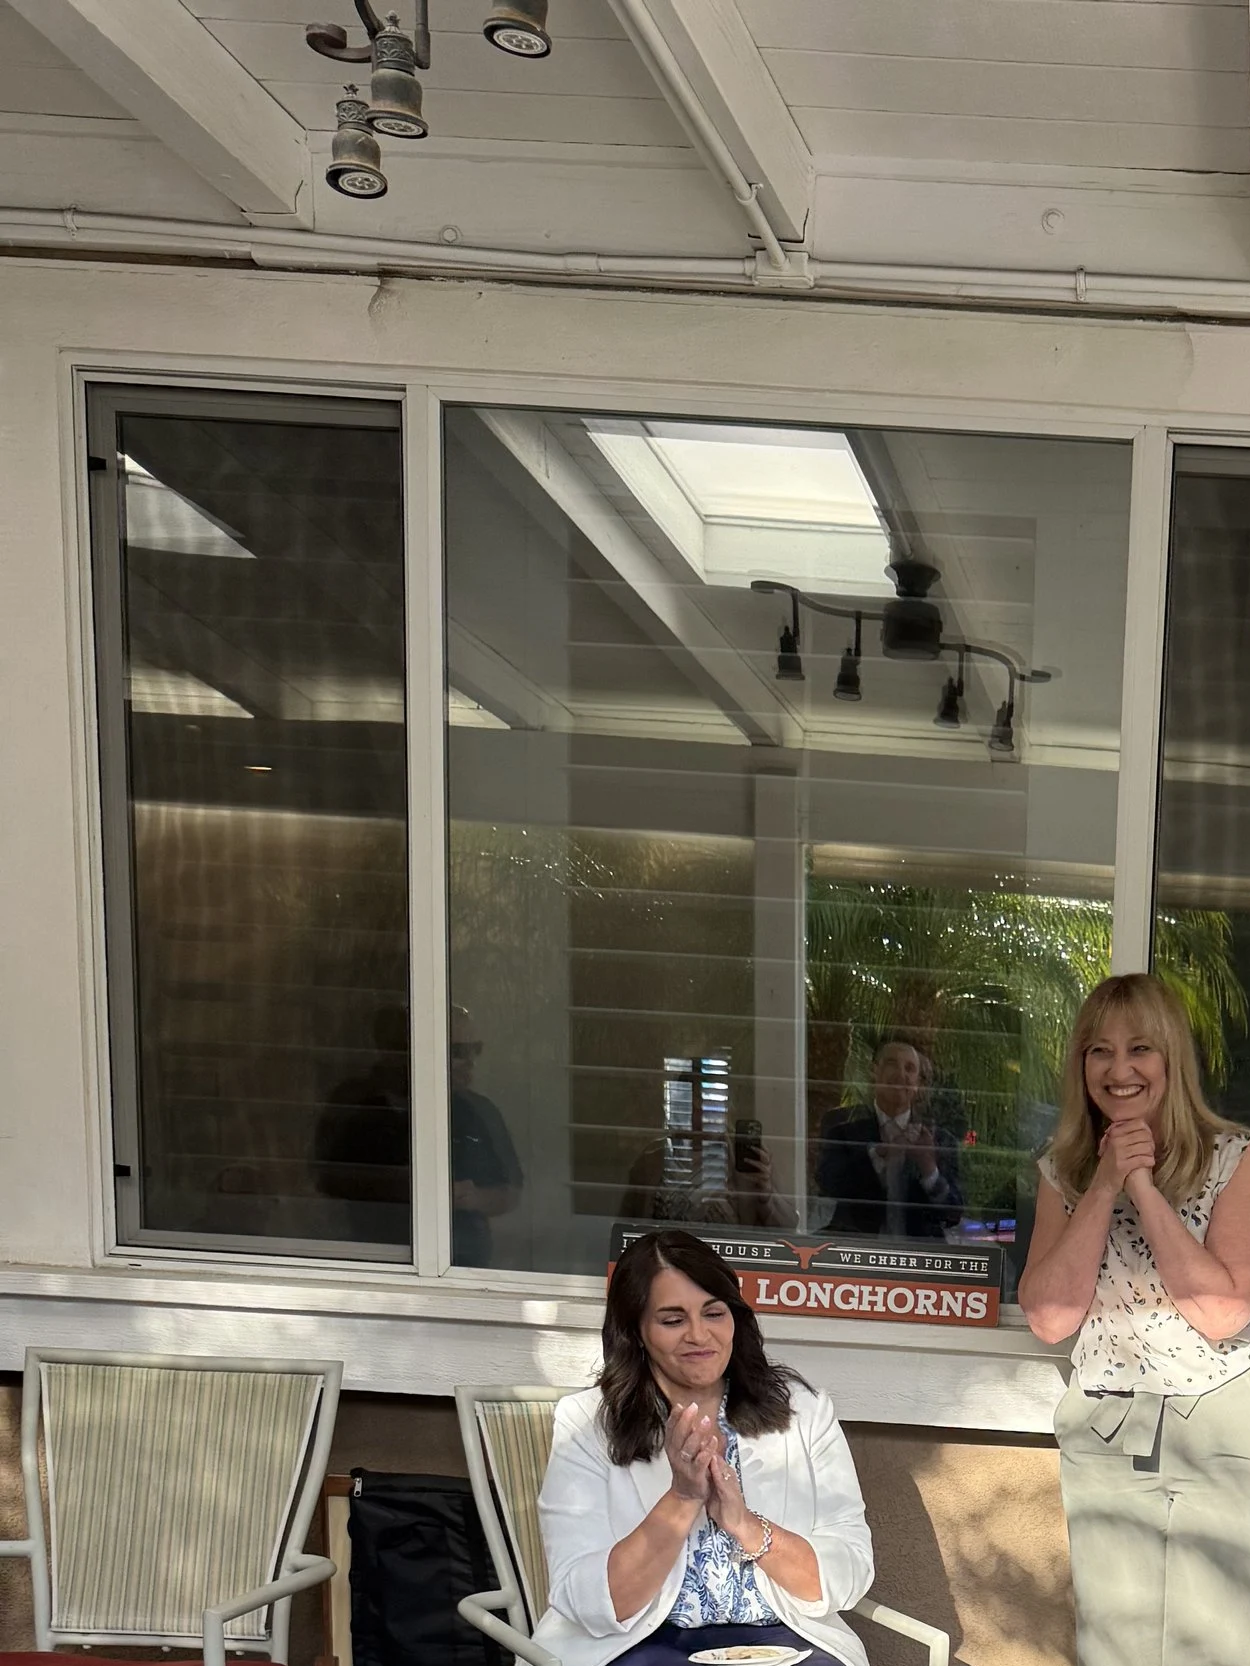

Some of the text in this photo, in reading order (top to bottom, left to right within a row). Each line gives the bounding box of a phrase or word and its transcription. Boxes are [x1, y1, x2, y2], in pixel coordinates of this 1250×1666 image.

[840, 1252, 988, 1272] WE CHEER FOR THE
[756, 1278, 988, 1320] LONGHORNS
